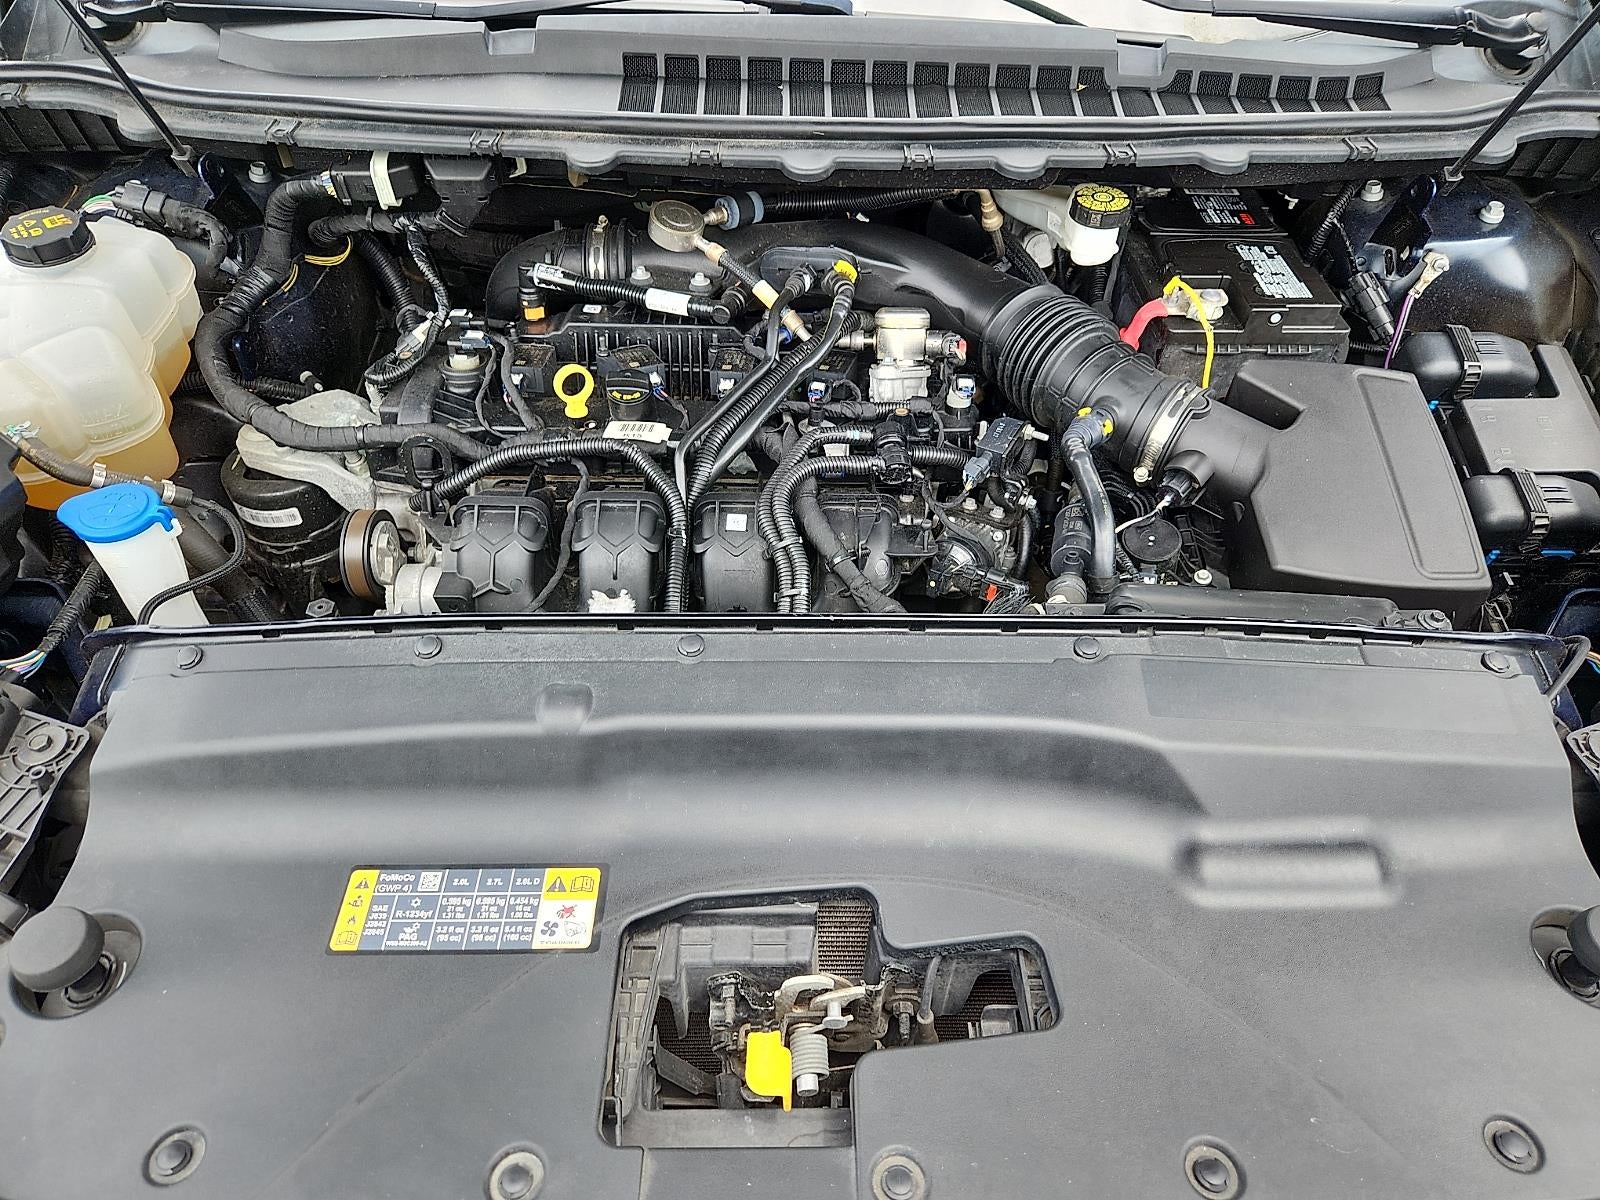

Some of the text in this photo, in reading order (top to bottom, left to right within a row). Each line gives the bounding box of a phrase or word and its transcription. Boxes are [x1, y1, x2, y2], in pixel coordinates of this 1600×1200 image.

[380, 873, 416, 882] FoMoCo
[452, 878, 470, 886] 2.0L
[375, 884, 413, 894] (GWP 4)
[462, 897, 472, 907] kg
[496, 897, 506, 907] kg
[530, 897, 539, 907] kg
[371, 904, 389, 912] SAE
[395, 910, 433, 919] R-1234yf
[398, 932, 418, 941] PAG
